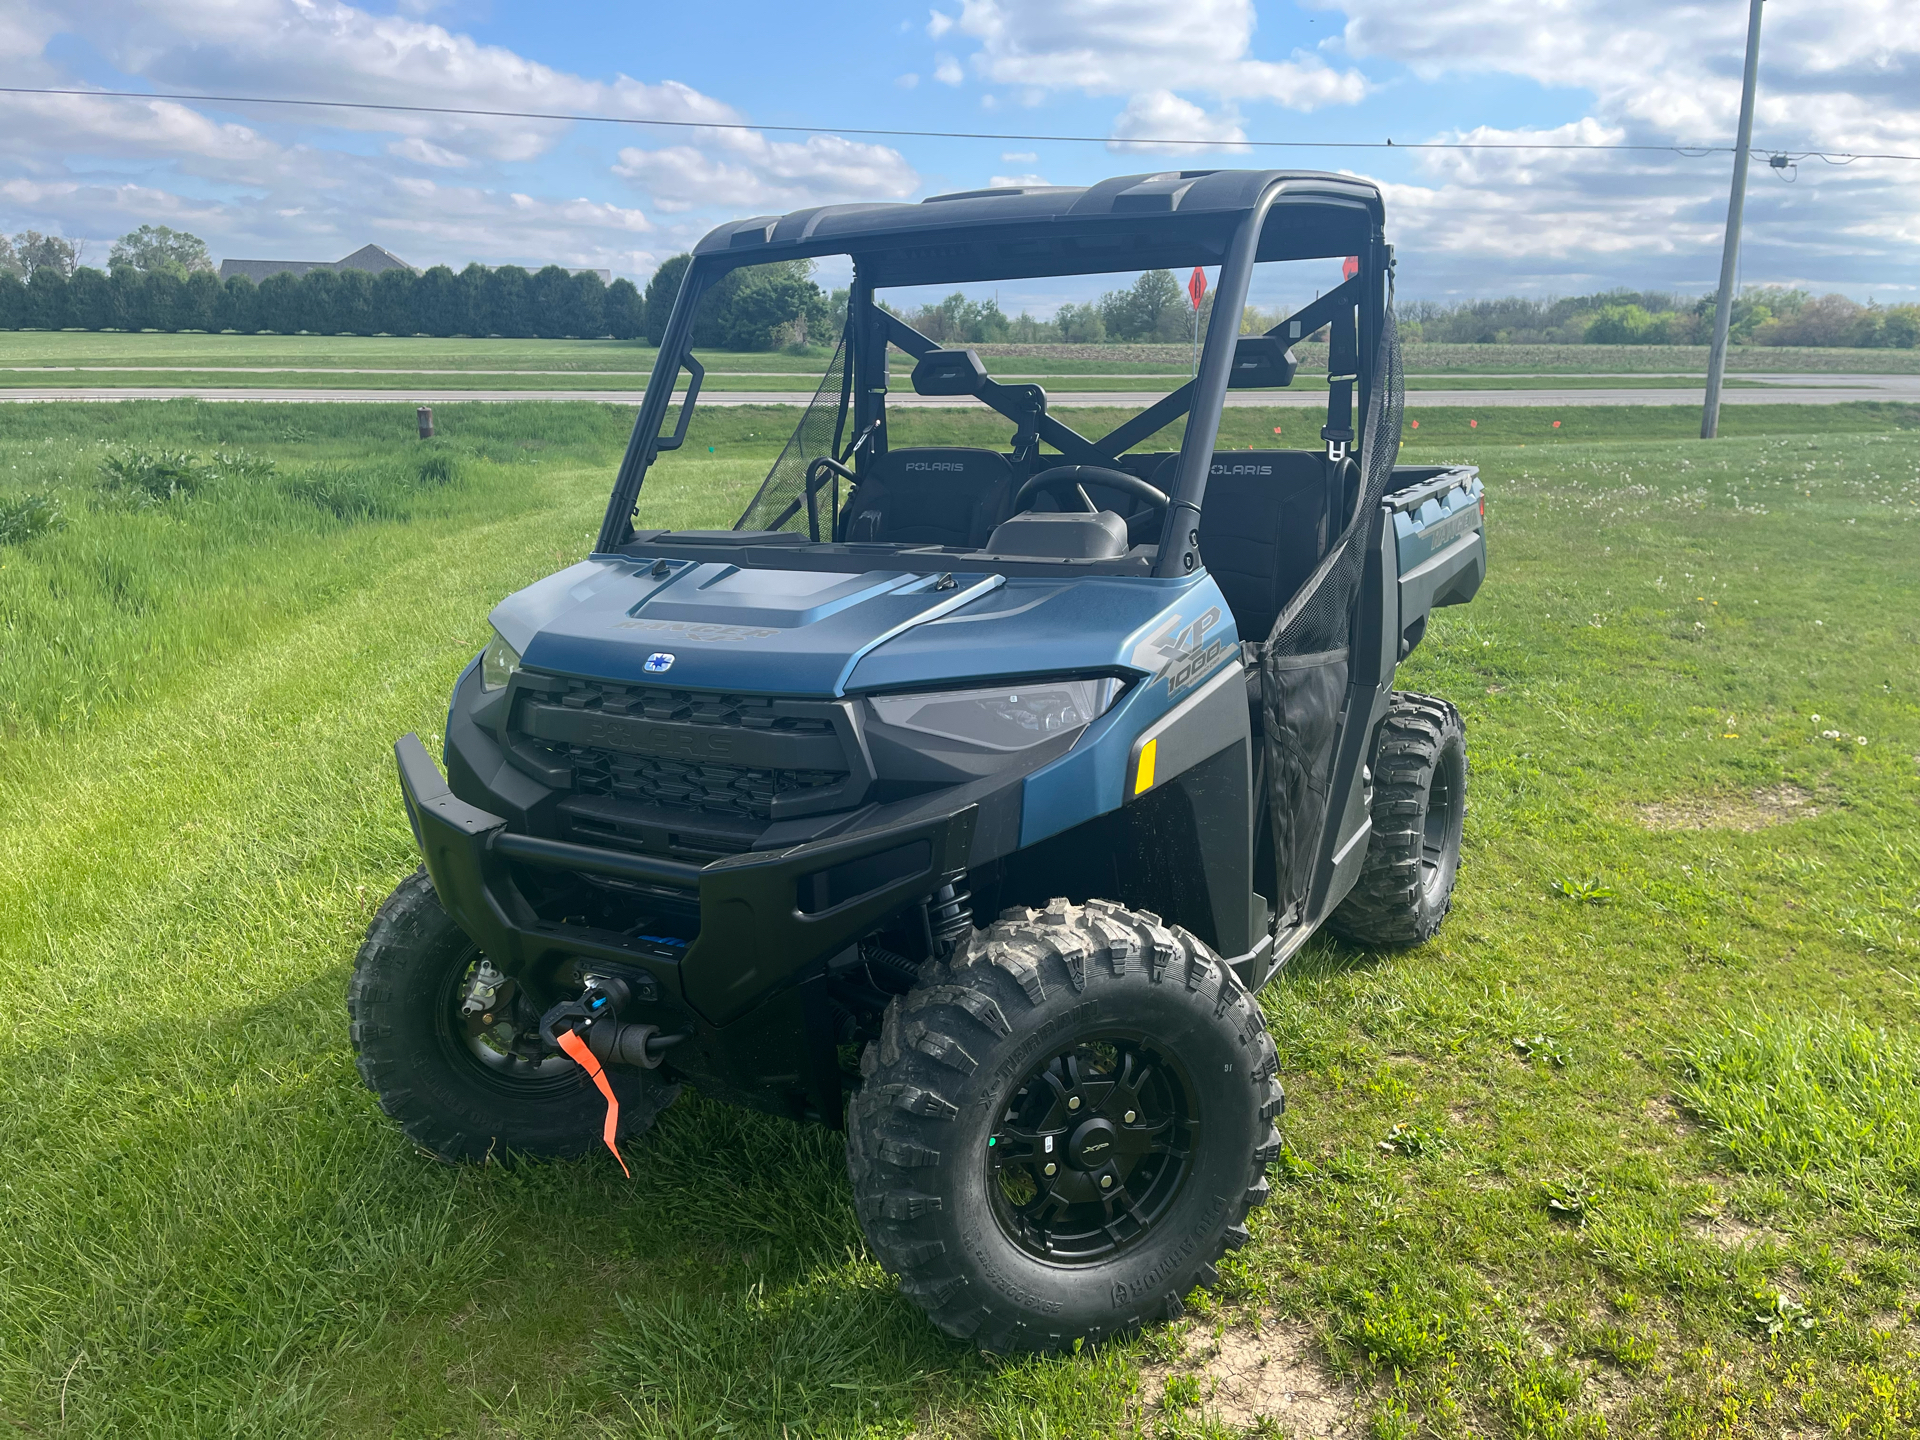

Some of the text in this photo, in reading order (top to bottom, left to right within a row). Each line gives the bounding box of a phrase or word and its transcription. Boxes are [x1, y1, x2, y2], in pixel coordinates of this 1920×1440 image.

[905, 462, 964, 472] POLARIS
[1210, 464, 1273, 475] OLARIS
[606, 621, 782, 639] RANGER
[1144, 605, 1222, 691] XP
[1167, 639, 1221, 695] 1000
[585, 718, 735, 760] POLARIS
[978, 999, 1100, 1111] X-TERRAIN
[1082, 1142, 1110, 1154] XP
[1130, 1194, 1228, 1297] PRO ARMOR
